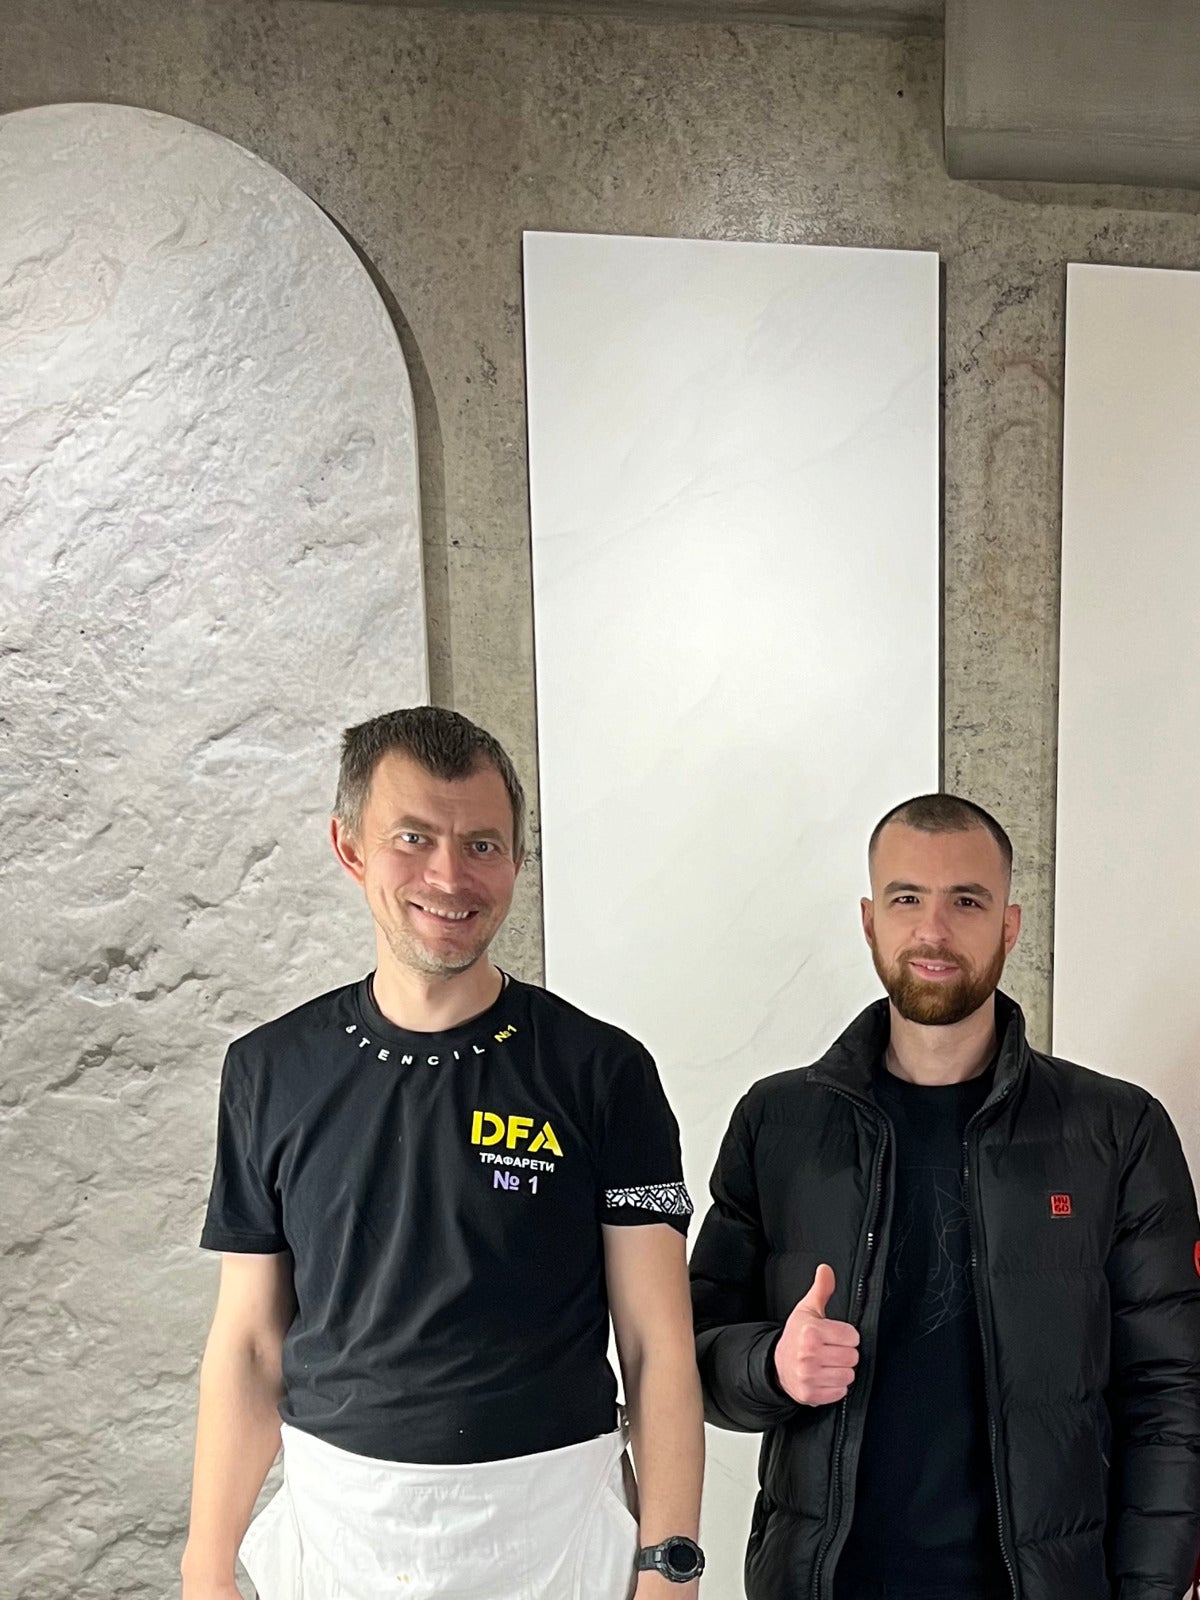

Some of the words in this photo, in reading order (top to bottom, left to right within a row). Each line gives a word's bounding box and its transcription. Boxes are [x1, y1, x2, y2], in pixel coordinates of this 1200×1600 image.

[471, 1110, 564, 1157] DFA
[479, 1152, 555, 1173] ТРАФАРЕТИ
[493, 1169, 520, 1191] №
[528, 1175, 538, 1194] 1
